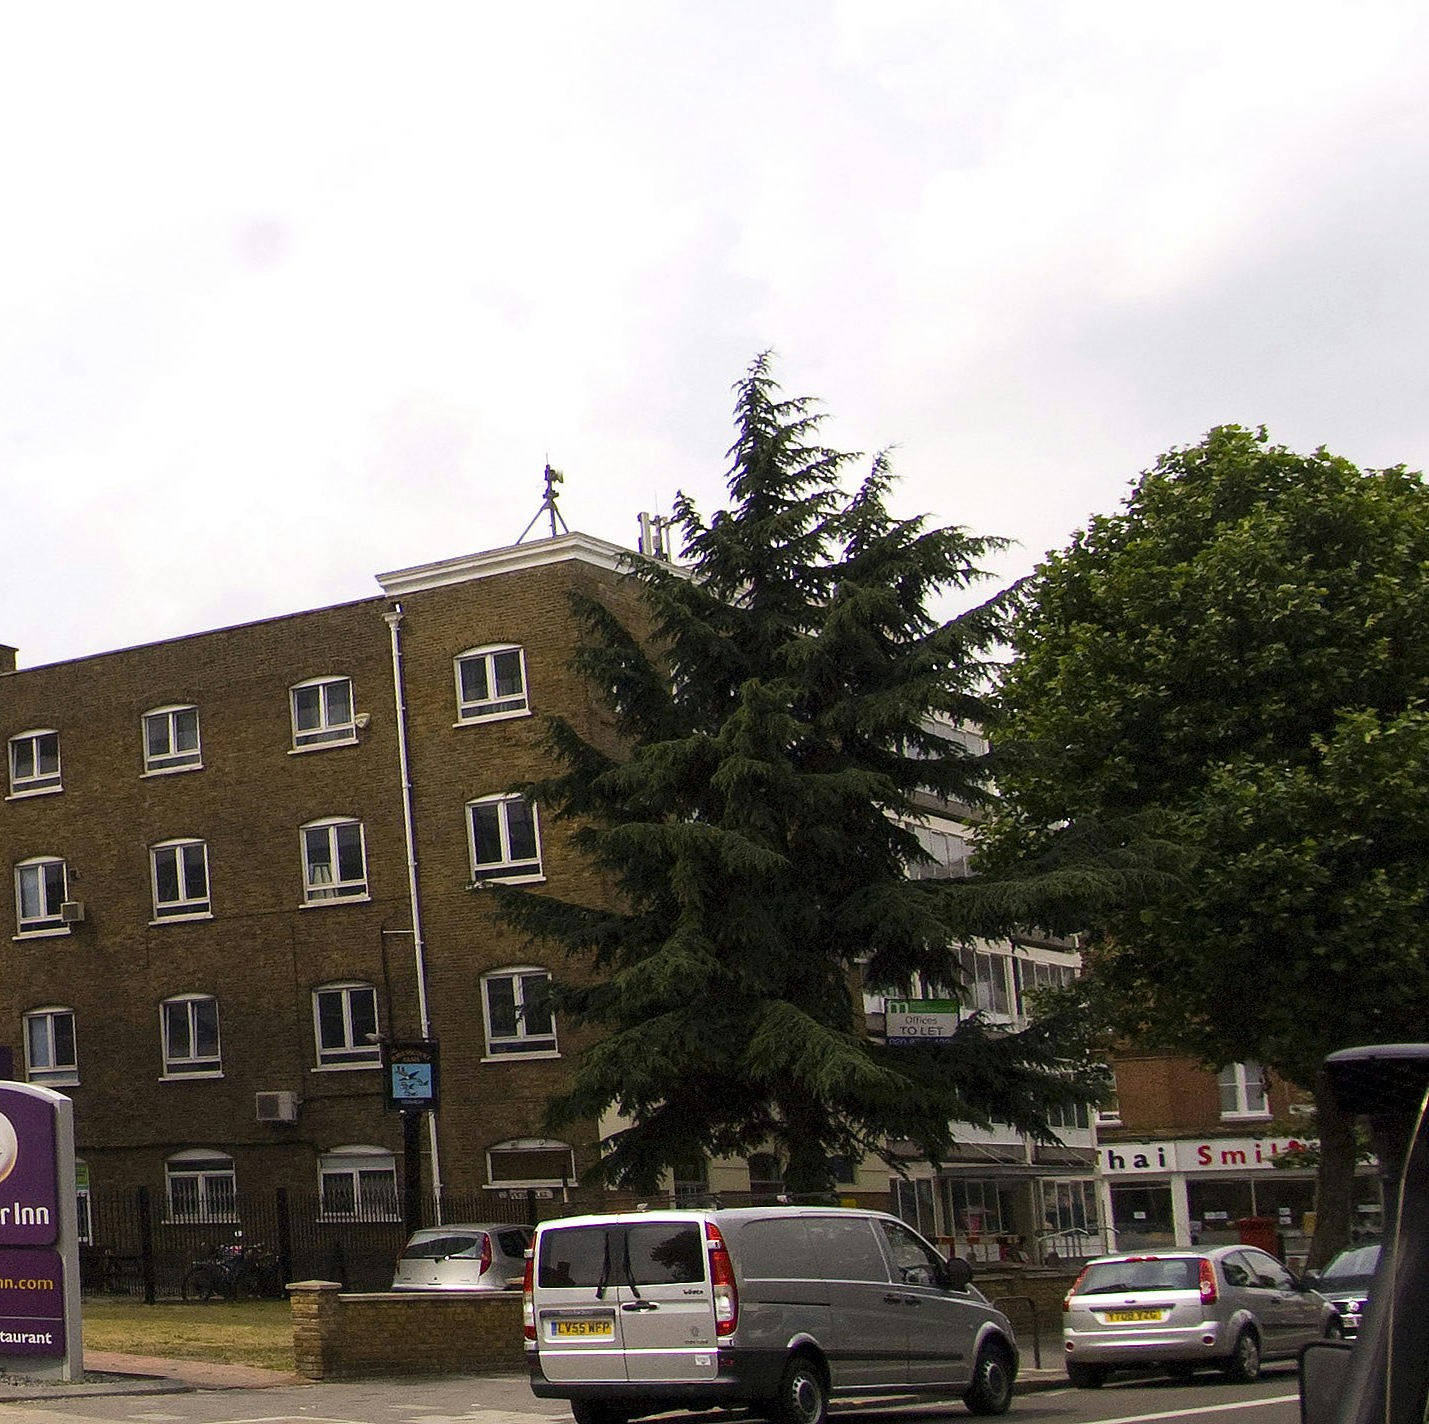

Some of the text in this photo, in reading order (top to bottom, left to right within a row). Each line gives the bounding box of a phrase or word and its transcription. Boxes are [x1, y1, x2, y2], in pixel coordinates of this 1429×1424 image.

[905, 1016, 938, 1025] Offices
[900, 1026, 944, 1036] TO LET
[14, 1202, 50, 1225] Inn
[558, 1321, 586, 1333] LV55
